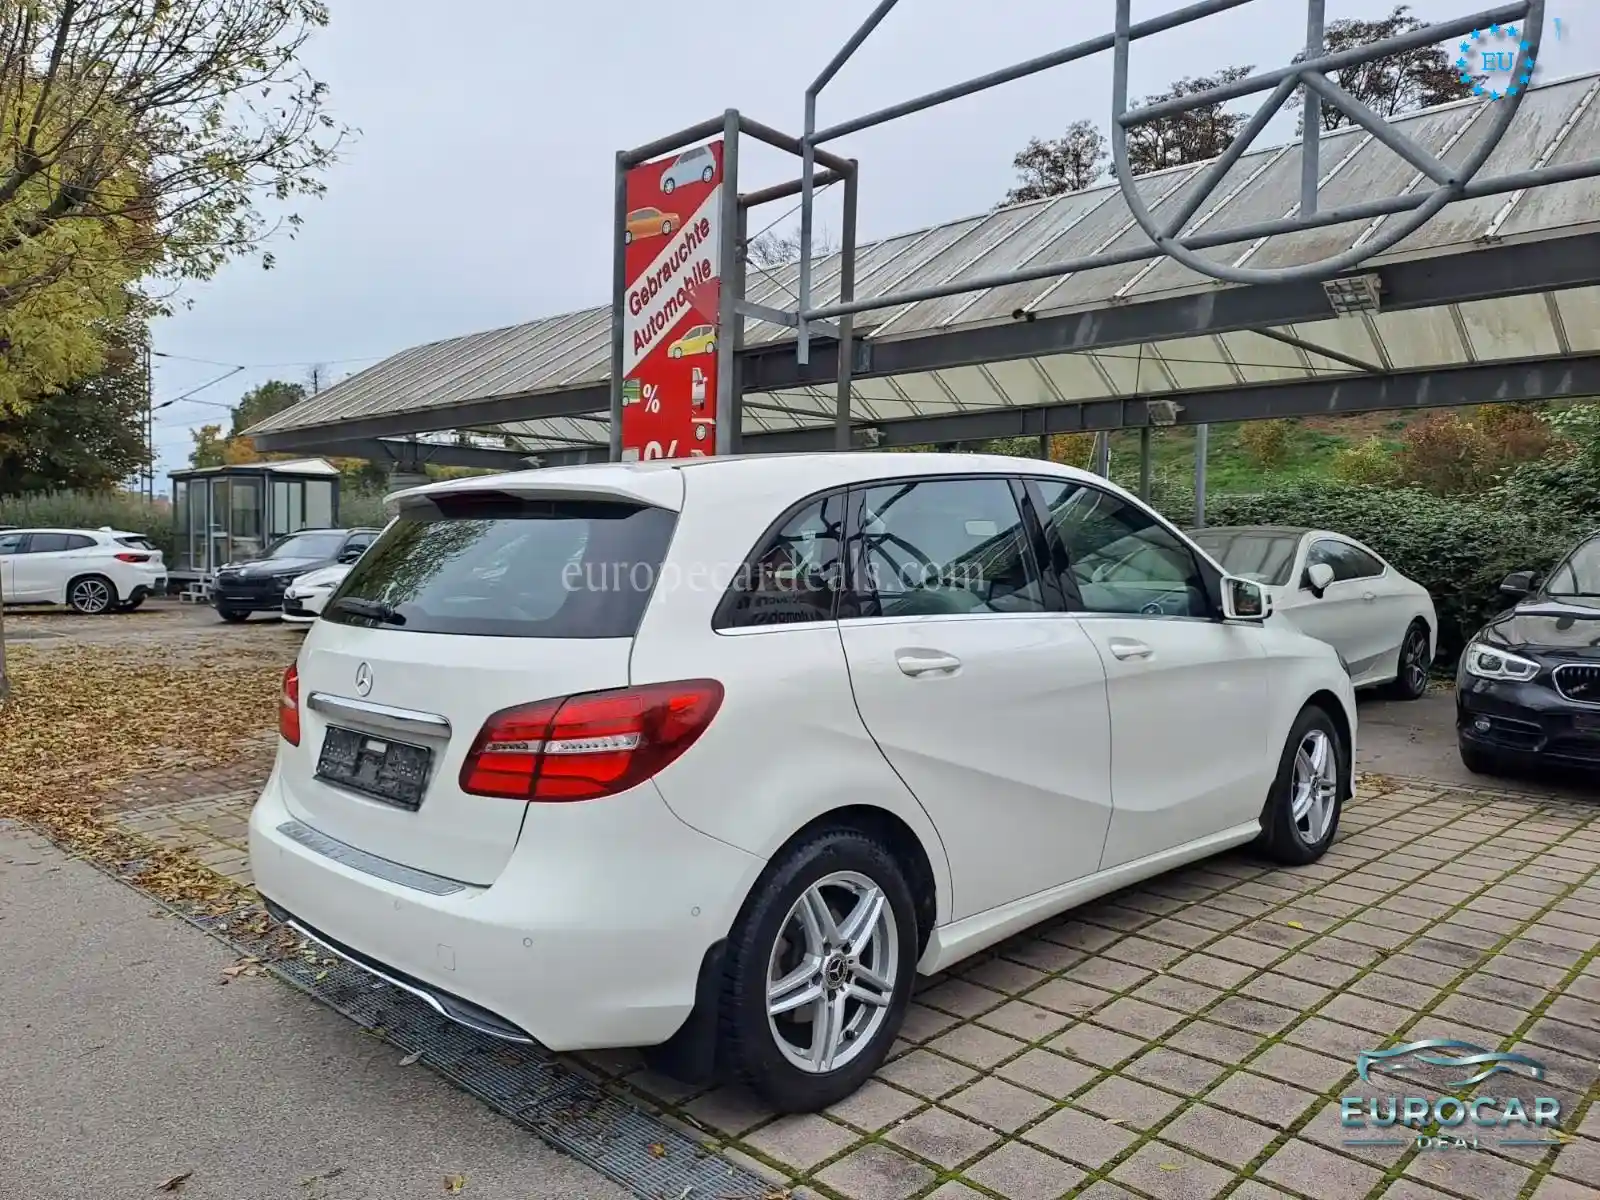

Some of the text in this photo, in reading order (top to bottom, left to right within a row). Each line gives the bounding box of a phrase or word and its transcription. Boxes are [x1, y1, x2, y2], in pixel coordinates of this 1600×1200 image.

[629, 217, 710, 316] Gebrauchte
[634, 258, 712, 356] Automobile
[642, 383, 660, 414] %
